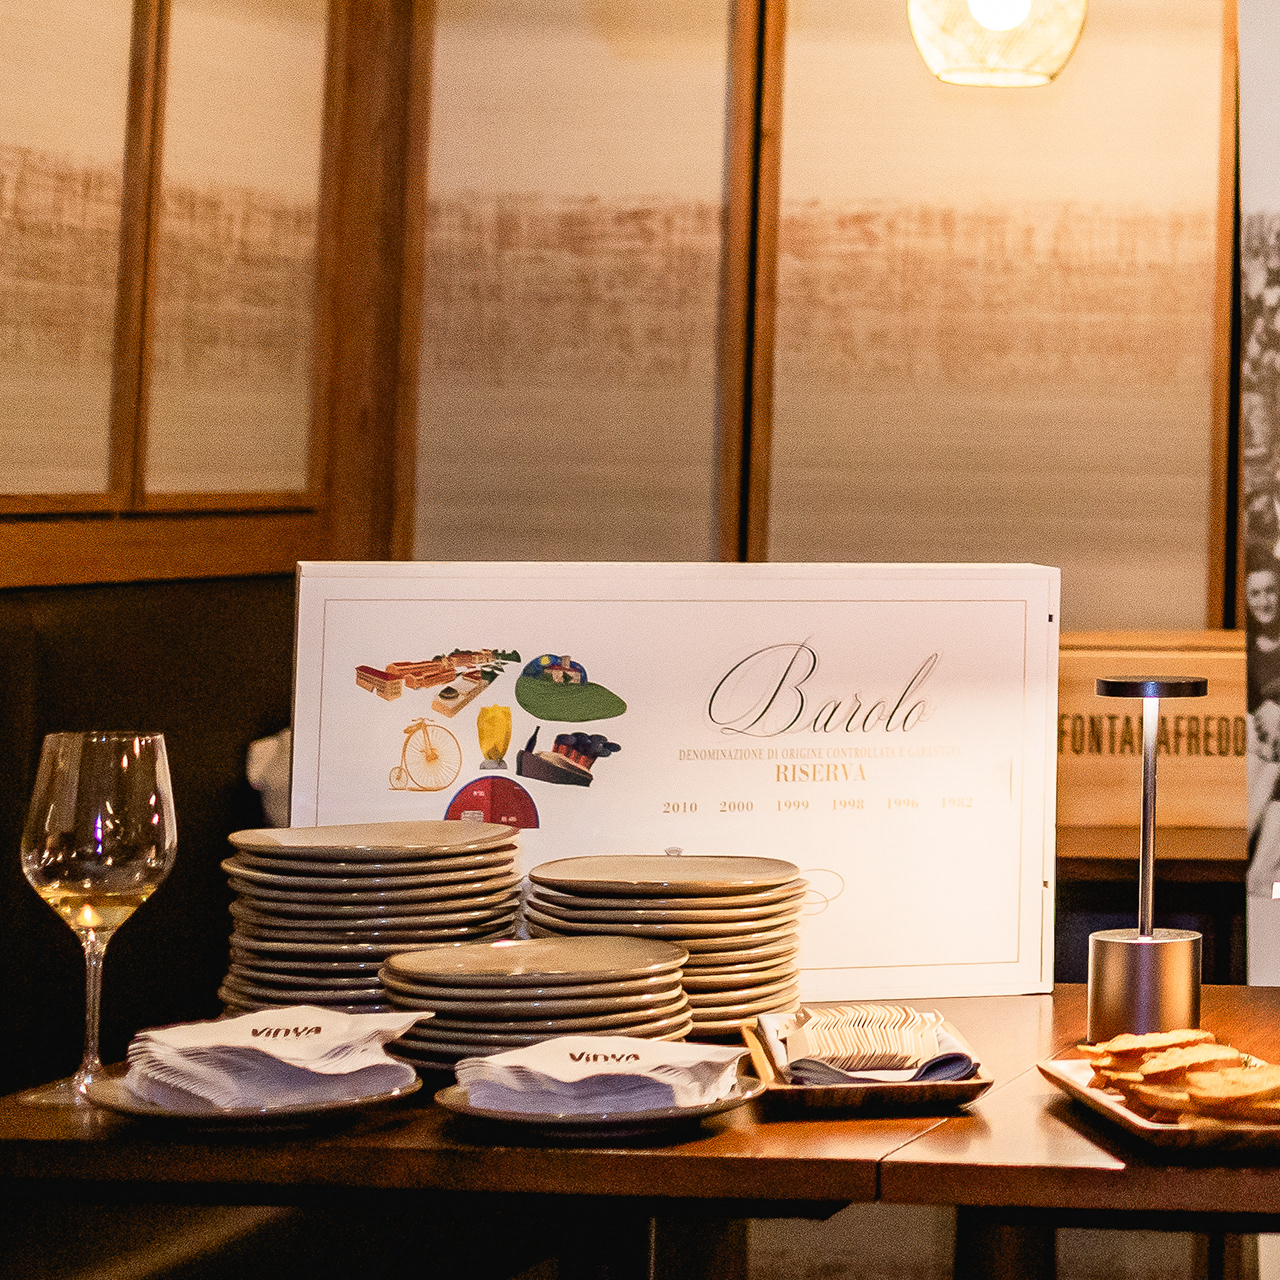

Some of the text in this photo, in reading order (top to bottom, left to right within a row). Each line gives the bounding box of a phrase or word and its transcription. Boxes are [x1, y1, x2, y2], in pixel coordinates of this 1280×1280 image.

[707, 634, 940, 738] Barolo
[1058, 713, 1246, 756] FONTAAFREDD
[679, 748, 764, 761] DENOMINAZIONE
[767, 748, 778, 760] DI
[781, 747, 823, 760] ORIGINE
[826, 746, 896, 759] CONTROLLATA
[775, 763, 866, 783] RISERVA
[663, 796, 974, 814] 2010 2000 1999 1998 1996 1982
